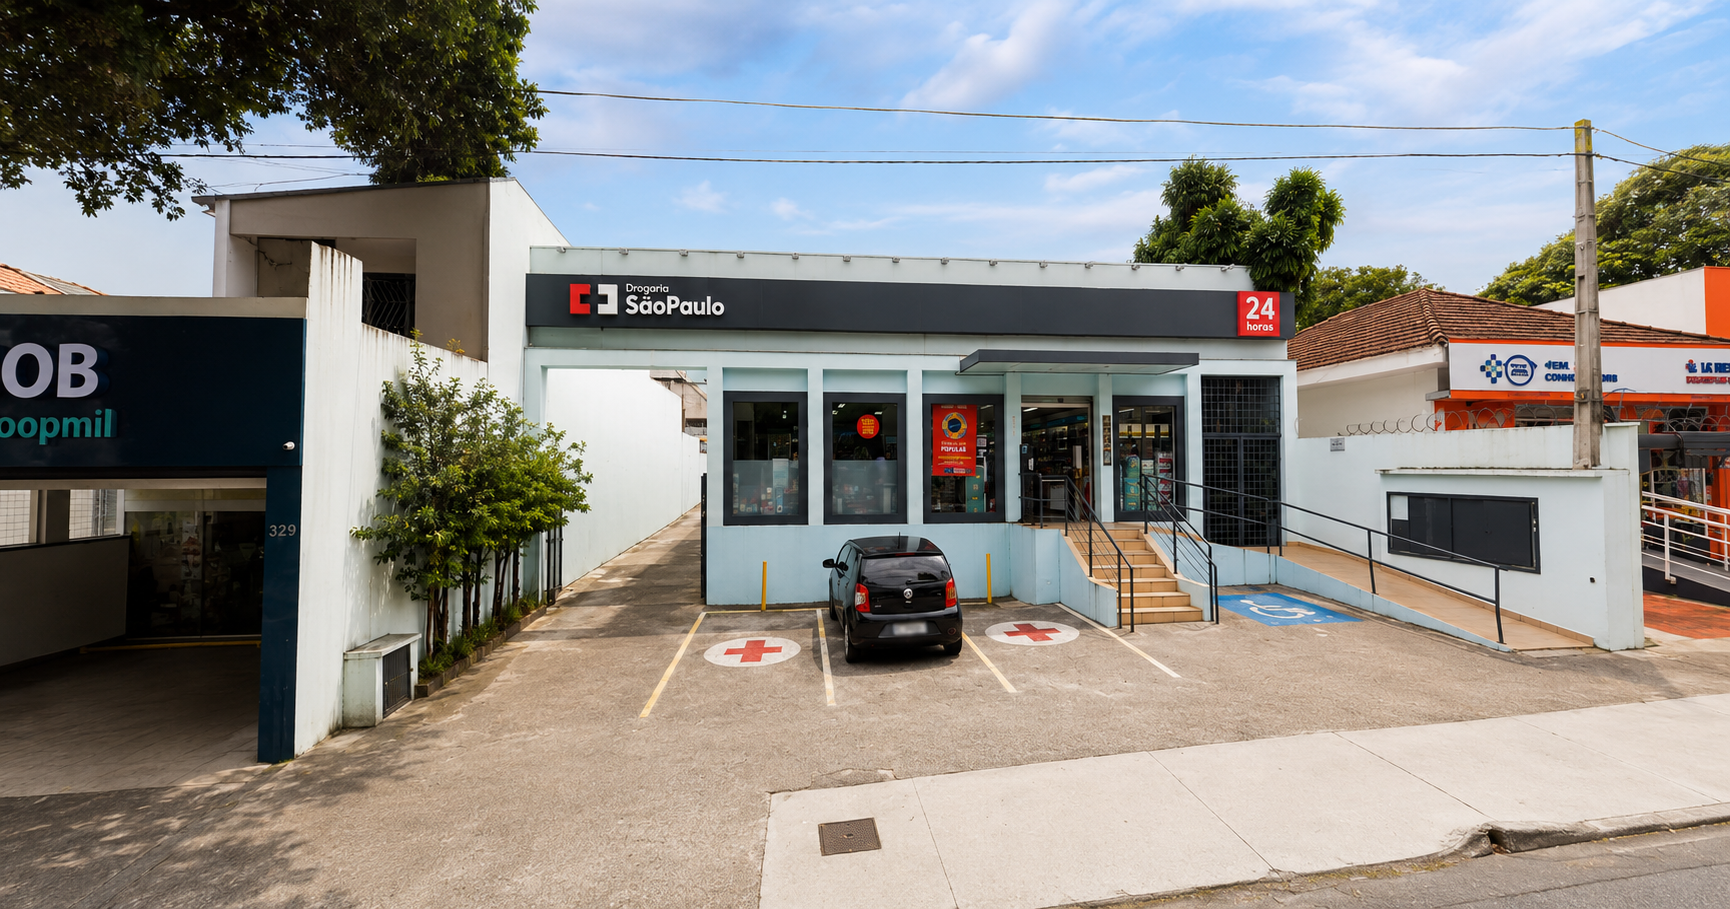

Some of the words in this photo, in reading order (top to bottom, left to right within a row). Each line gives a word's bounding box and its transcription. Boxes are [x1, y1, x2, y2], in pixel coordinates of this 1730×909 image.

[625, 283, 669, 295] Drogaria
[1246, 296, 1275, 320] 24
[1246, 321, 1274, 331] horas
[269, 524, 297, 538] 329
